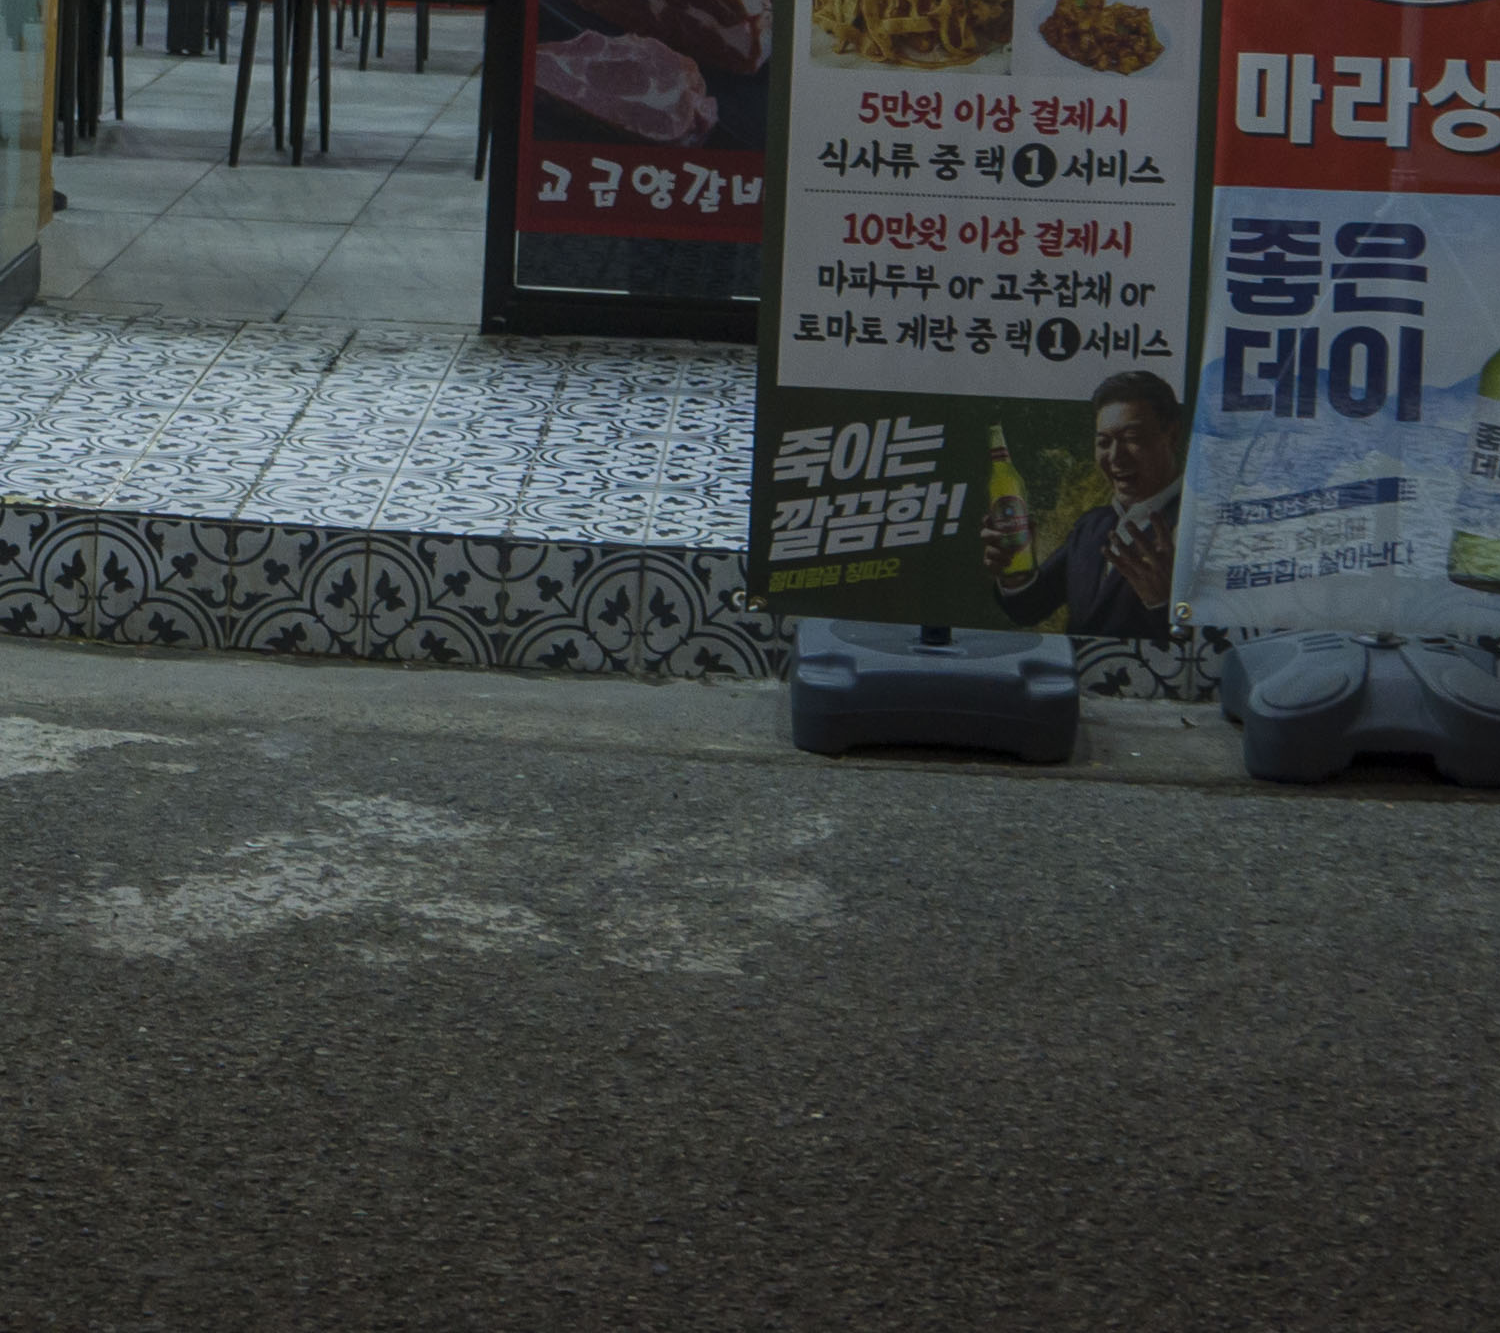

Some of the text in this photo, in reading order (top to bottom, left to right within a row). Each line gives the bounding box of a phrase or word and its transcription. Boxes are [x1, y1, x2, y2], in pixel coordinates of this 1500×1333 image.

[858, 90, 1129, 137] 5만원 이상 결제시
[816, 137, 1166, 187] 식사류 중 서비스
[841, 211, 1133, 259] 10만원 이상 결제시
[817, 259, 1156, 310] 마파두부 or 고추잡채 or
[1225, 217, 1429, 318] 좋은
[793, 309, 1173, 361] 토마토 계란 중 서비스
[1221, 324, 1425, 423] 데이
[772, 414, 945, 488] 죽이는
[767, 481, 969, 562] 깔끔함!
